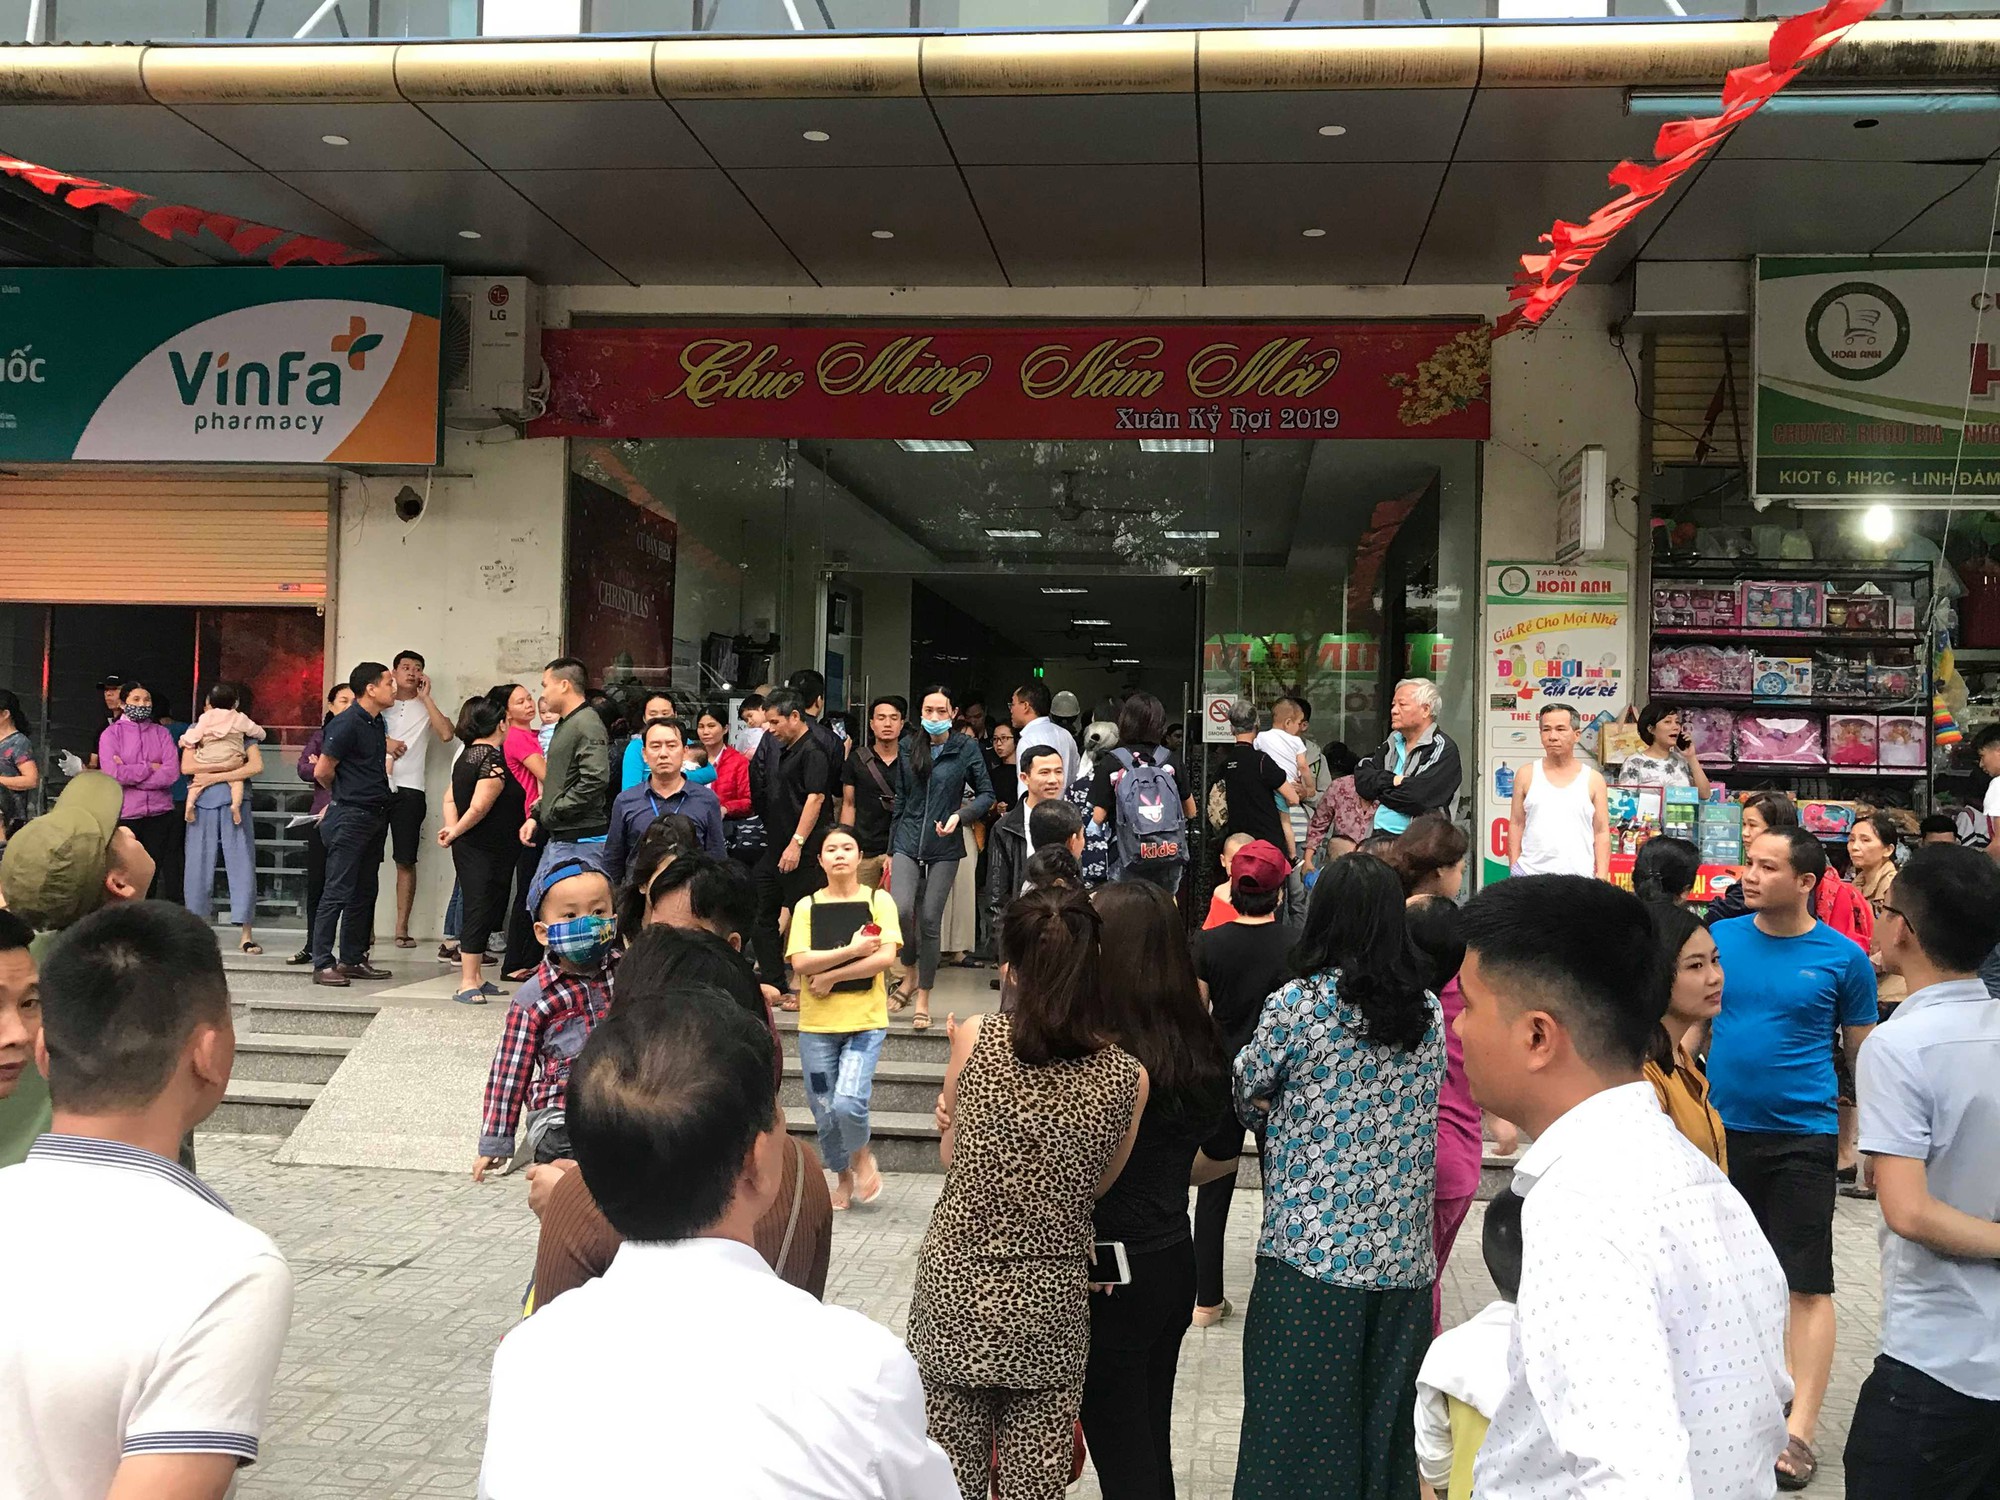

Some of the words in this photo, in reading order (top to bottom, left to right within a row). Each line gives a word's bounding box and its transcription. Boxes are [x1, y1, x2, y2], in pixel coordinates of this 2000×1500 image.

[489, 309, 507, 321] LG
[1859, 350, 1882, 359] ANH
[664, 337, 804, 408] Chúc
[816, 336, 993, 416] Mừng
[1019, 335, 1165, 400] Năm
[1186, 336, 1342, 399] Mới
[193, 412, 325, 434] pharmacy
[1115, 408, 1180, 429] Xuân
[1189, 404, 1222, 434] Kỷ
[1230, 408, 1271, 433] Hợi
[1278, 408, 1340, 429] 2019
[1912, 423, 1944, 446] BIA
[1779, 470, 1823, 485] KIOT
[1846, 471, 1896, 486] HH2C
[1912, 472, 1953, 486] LINH
[1536, 578, 1576, 593] HOÀI
[1580, 580, 1612, 593] ANH
[599, 581, 649, 618] CHRISTMAS
[1493, 626, 1515, 644] Giá
[1517, 619, 1533, 636] Rẻ
[1536, 616, 1560, 630] Cho
[1563, 611, 1587, 627] Mọi
[1591, 611, 1619, 627] Nhà
[1533, 658, 1583, 678] CHƠI
[1543, 684, 1566, 697] GIÁ
[1598, 681, 1618, 697] RẺ
[1140, 840, 1179, 859] kids
